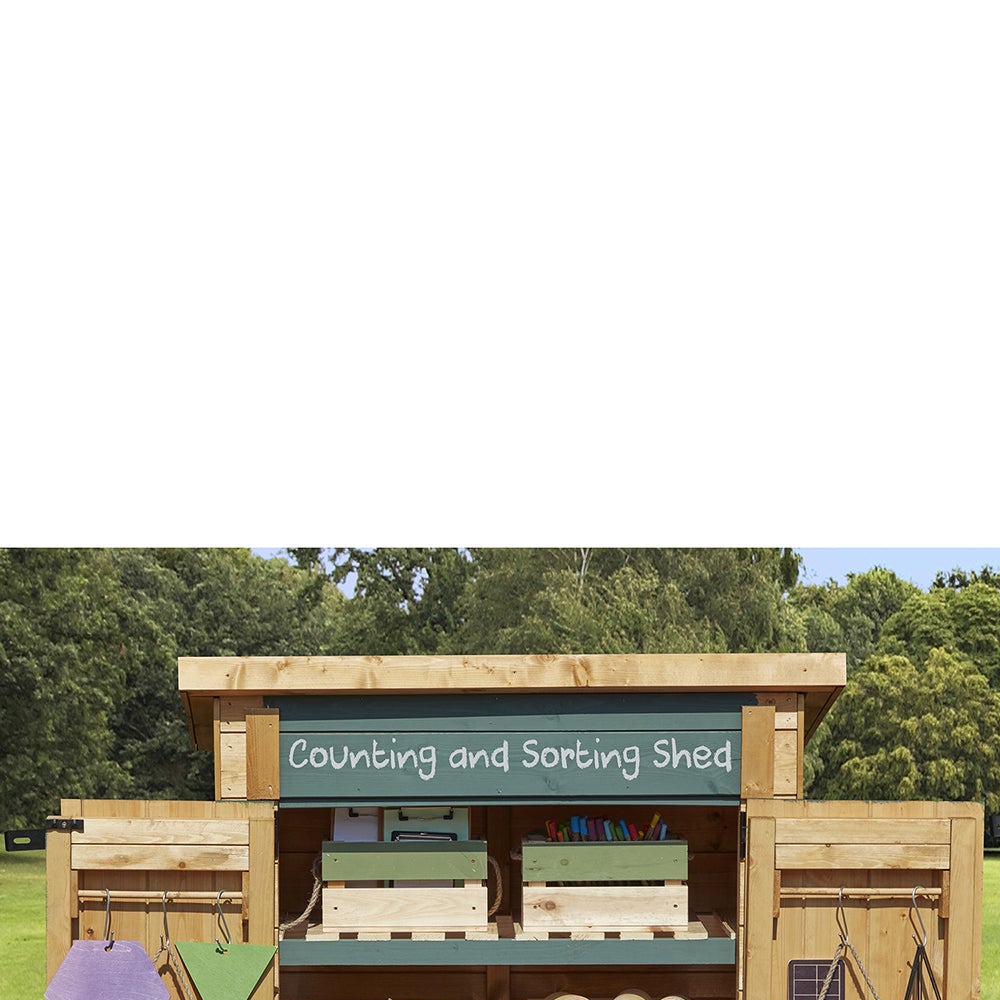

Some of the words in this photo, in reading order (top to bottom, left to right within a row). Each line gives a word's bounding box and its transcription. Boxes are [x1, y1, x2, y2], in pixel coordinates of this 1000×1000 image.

[289, 738, 437, 781] Counting
[449, 740, 510, 772] and
[522, 739, 640, 780] Sorting
[653, 739, 732, 772] Shed
